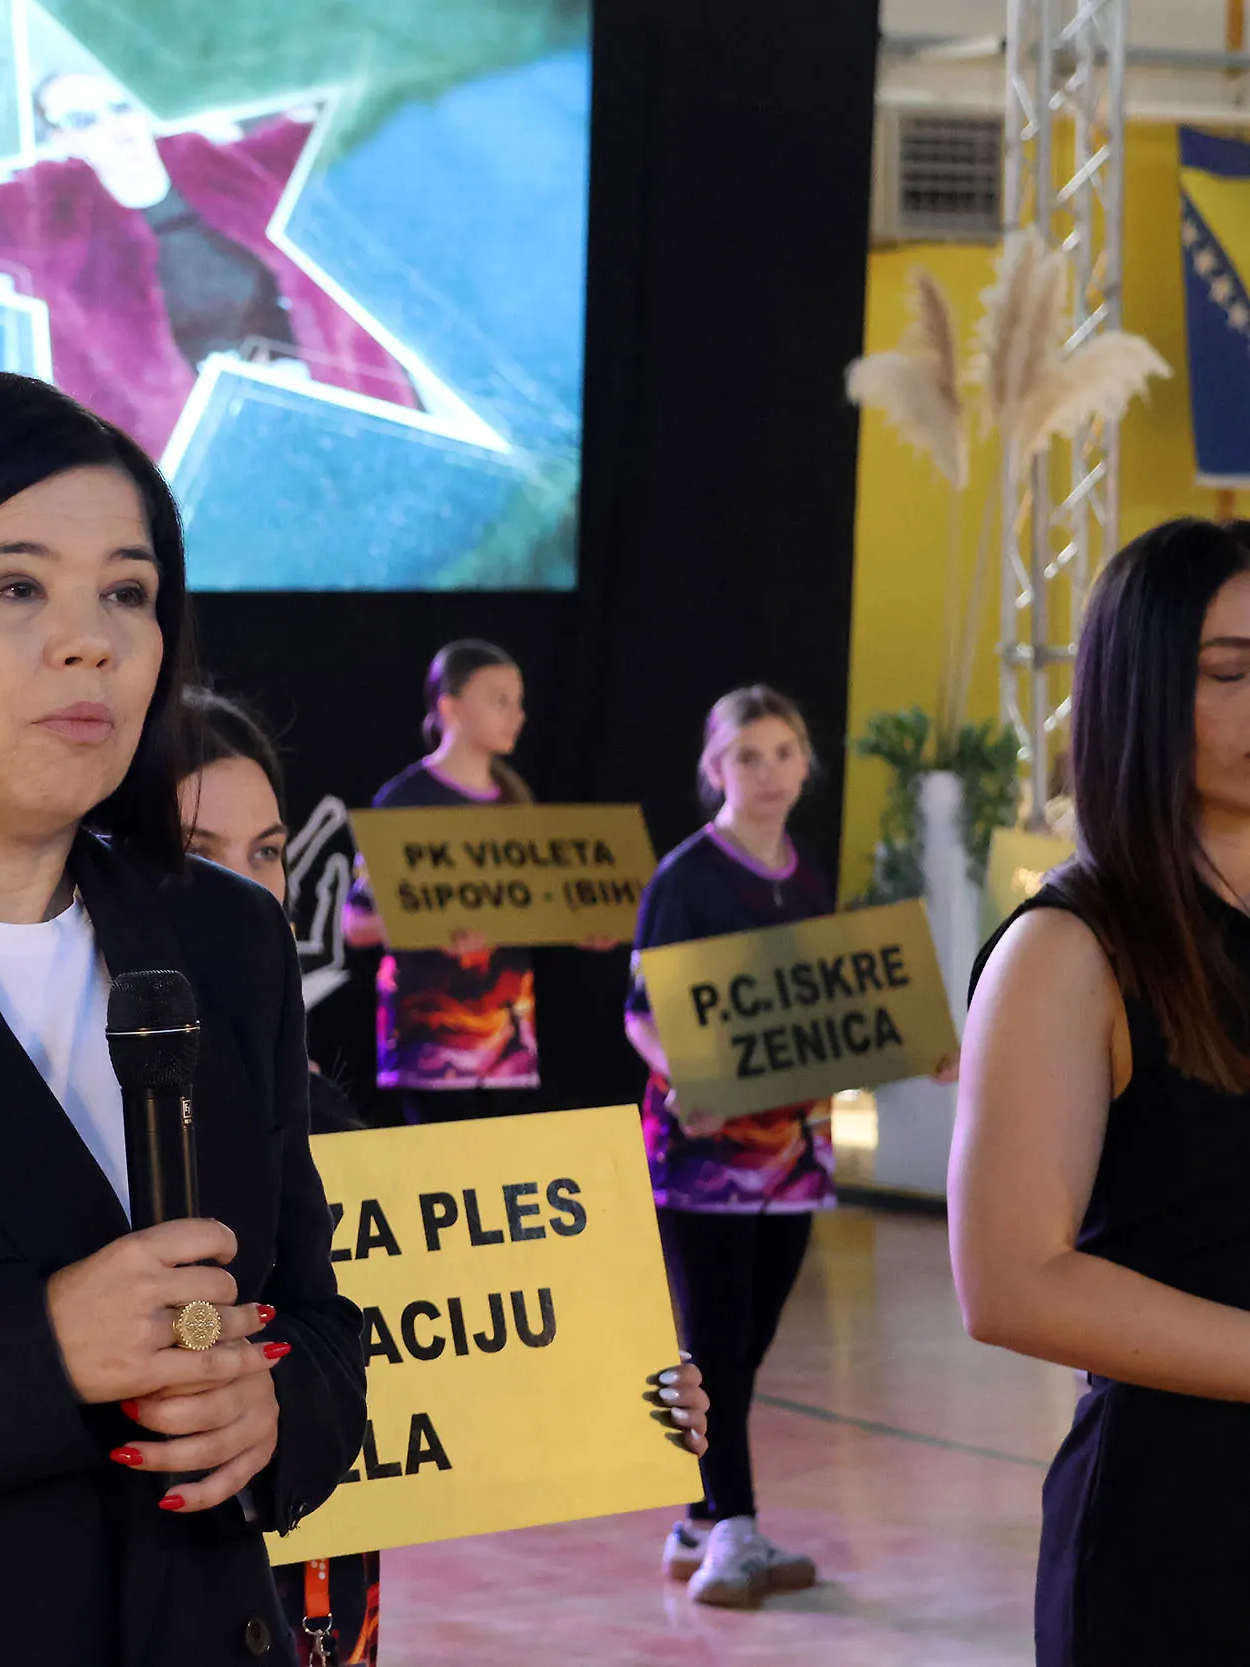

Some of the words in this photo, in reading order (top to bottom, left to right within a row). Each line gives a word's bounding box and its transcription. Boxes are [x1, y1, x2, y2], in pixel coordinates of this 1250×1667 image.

[404, 840, 456, 870] PK
[462, 837, 616, 869] VIOLETA
[730, 1006, 904, 1079] ZENICA
[418, 1177, 588, 1252] PLES
[363, 1287, 558, 1368] ACIJU
[337, 1411, 453, 1485] LA
